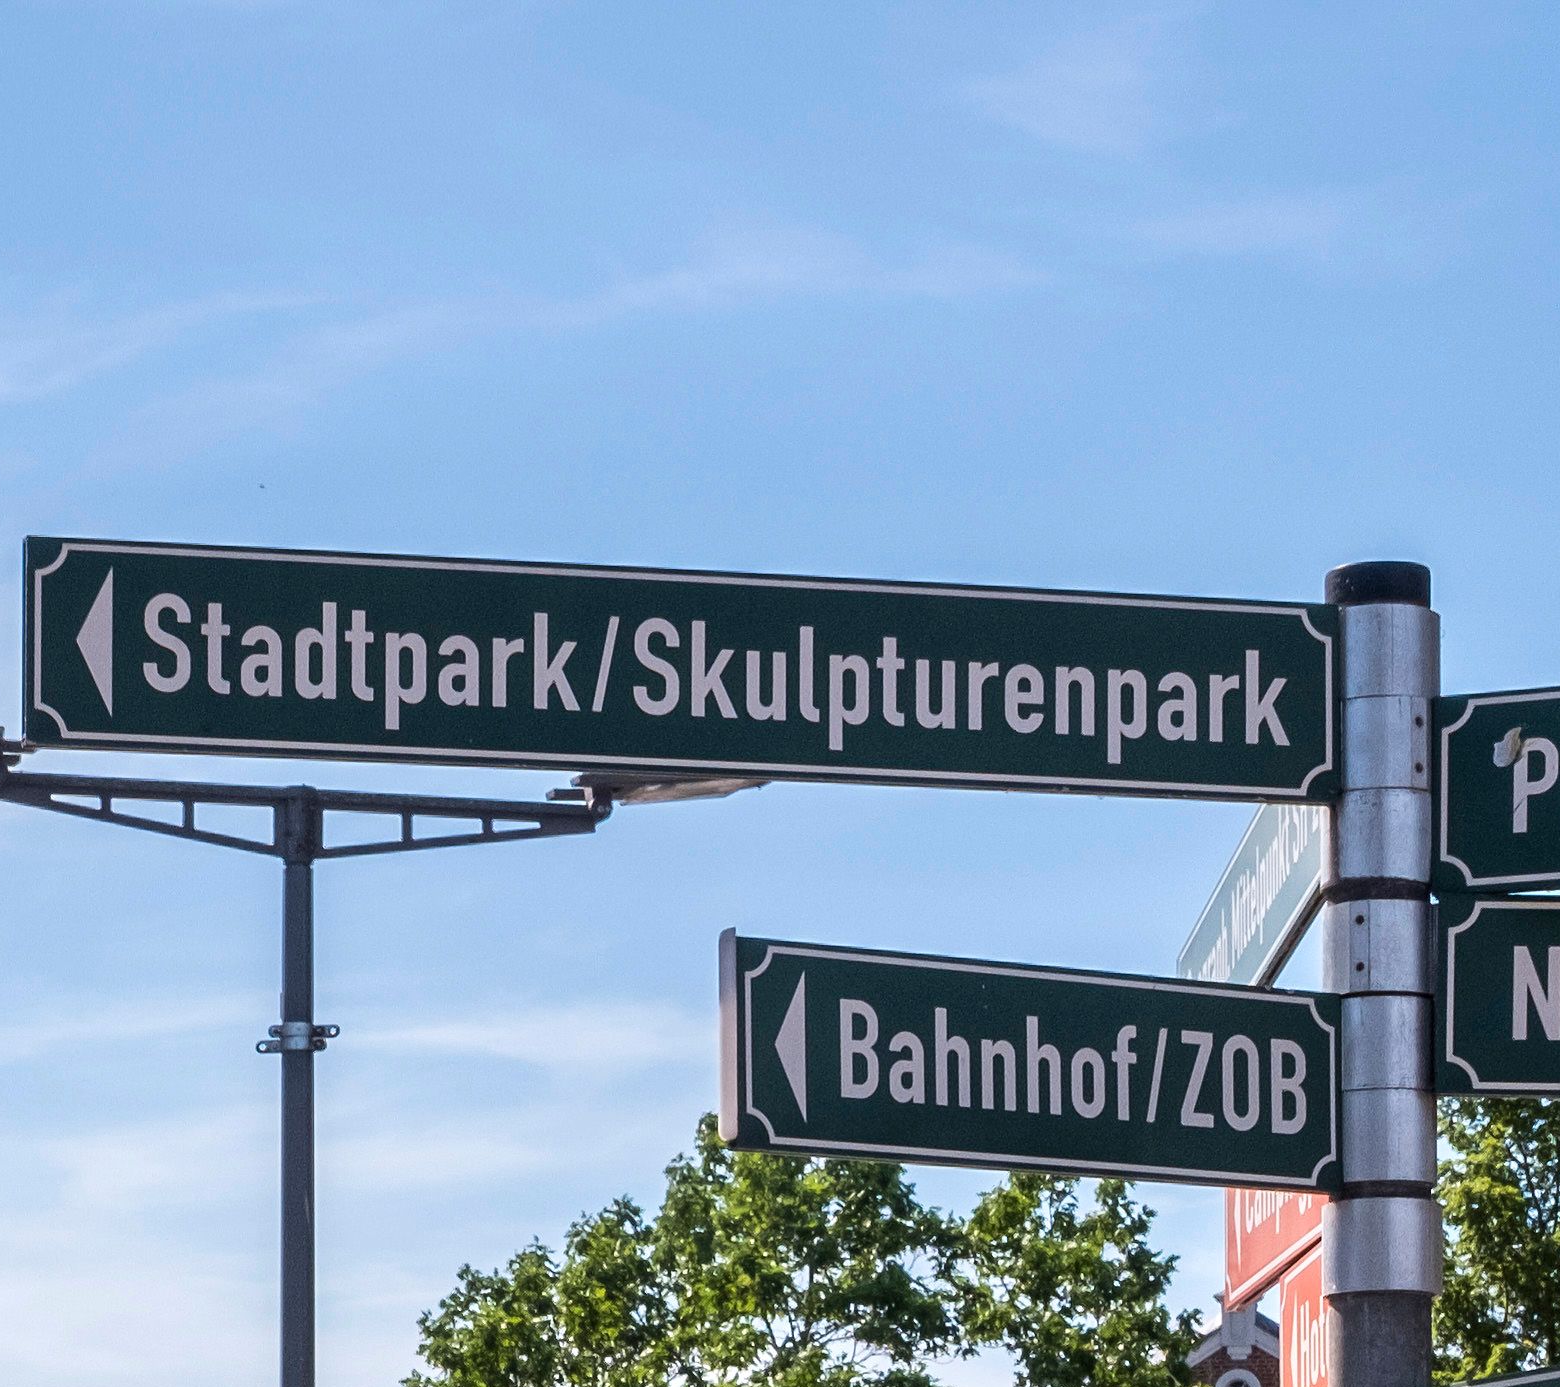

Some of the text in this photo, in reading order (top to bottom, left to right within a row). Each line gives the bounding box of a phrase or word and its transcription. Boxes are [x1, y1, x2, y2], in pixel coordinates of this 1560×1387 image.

[143, 592, 1291, 765] Stadtpark/Skulpturenpark
[1231, 804, 1292, 970] Mittelpunkt
[839, 998, 1308, 1135] Bahnhof/ZOB
